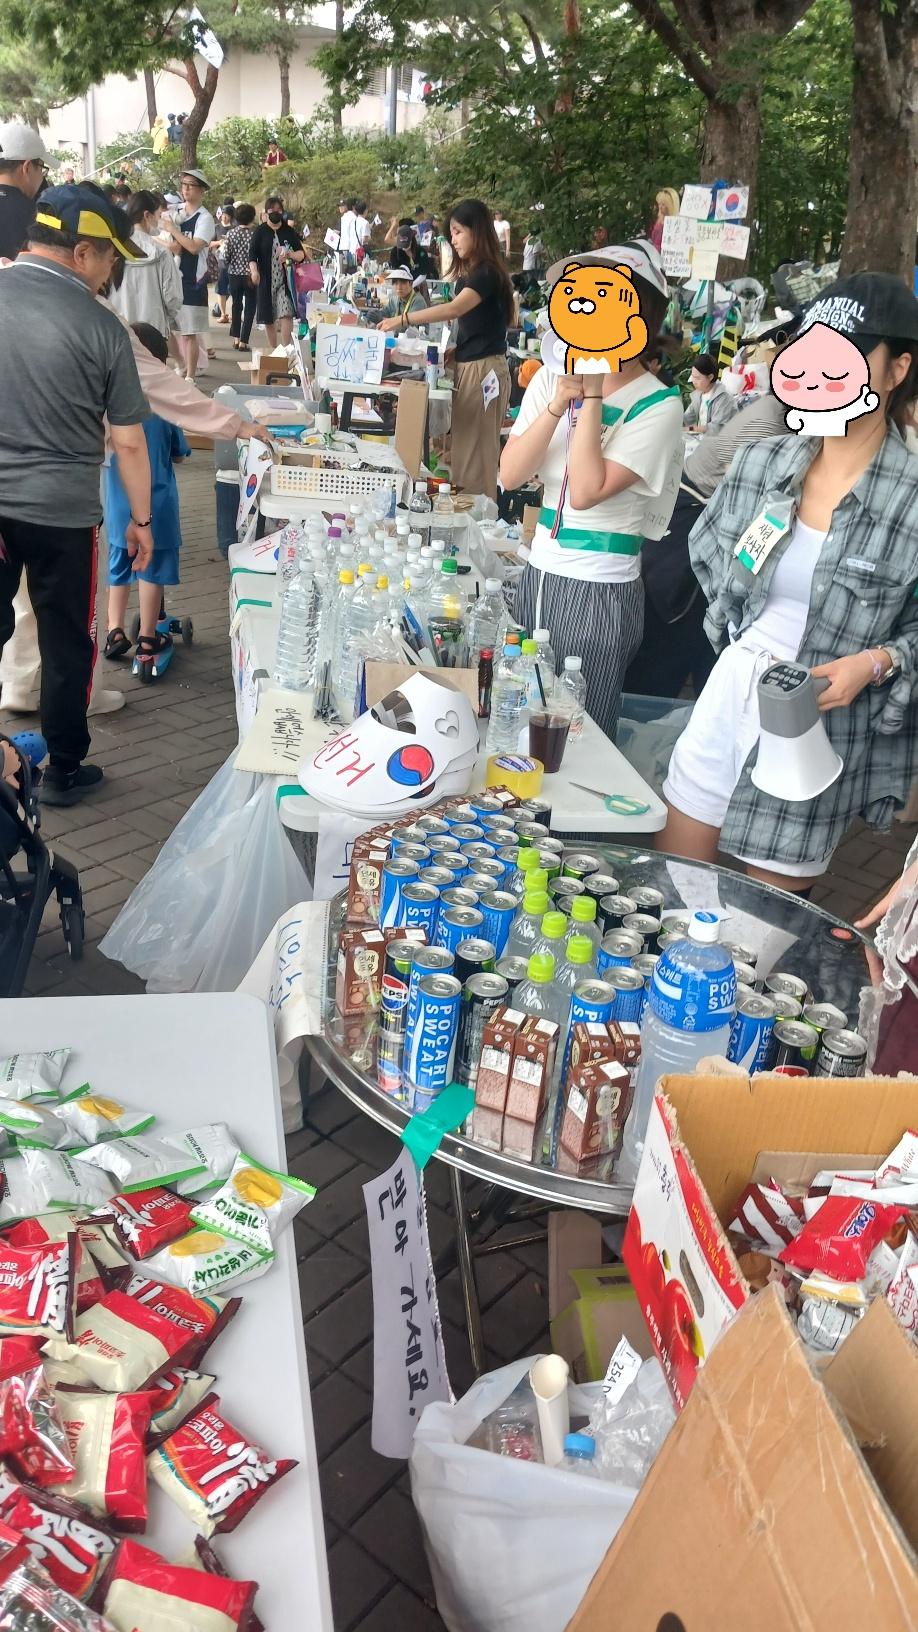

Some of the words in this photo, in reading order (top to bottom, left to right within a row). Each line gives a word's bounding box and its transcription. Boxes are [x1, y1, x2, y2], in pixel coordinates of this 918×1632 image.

[804, 296, 865, 322] MANUAL
[419, 1003, 440, 1077] SWEAT
[431, 1004, 453, 1086] POCARI
[214, 1197, 259, 1229] 기분이다
[151, 1302, 207, 1334] 초코파이
[377, 1168, 408, 1257] 받아
[399, 1262, 430, 1417] 가세요.
